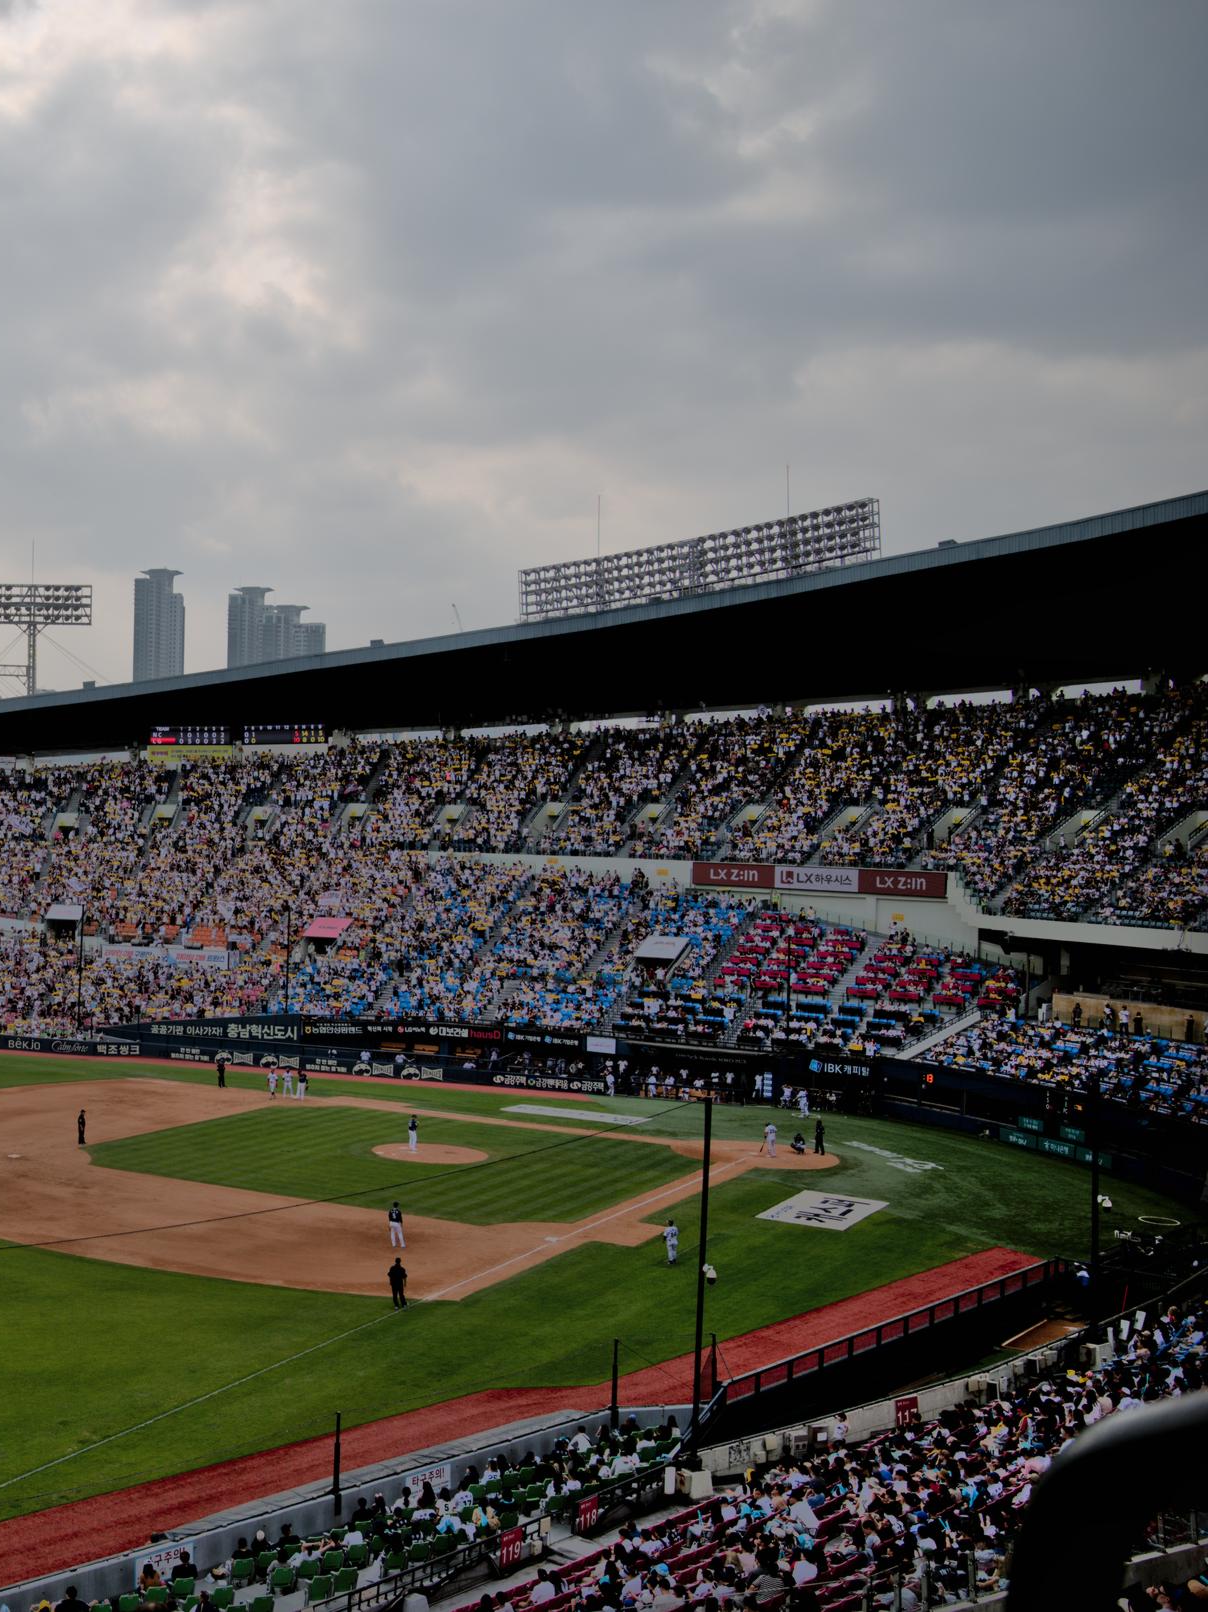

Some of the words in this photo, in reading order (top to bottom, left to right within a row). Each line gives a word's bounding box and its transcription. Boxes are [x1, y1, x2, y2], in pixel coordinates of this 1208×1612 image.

[709, 868, 728, 880] LX
[796, 872, 853, 886] LX하우시스
[876, 876, 894, 888] LX
[150, 1024, 184, 1035] 공공기관
[186, 1025, 224, 1036] 이사가자!
[226, 1023, 298, 1040] 충남혁신도시
[438, 1027, 469, 1038] 대보건설
[96, 1043, 140, 1055] 백조씽크
[824, 1062, 870, 1077] IBK캐피탈
[504, 1074, 527, 1086] 금강주택
[581, 1080, 605, 1092] 금강주택
[794, 1196, 871, 1223] 캐스퍼
[412, 1467, 445, 1486] 타구주의!
[580, 1509, 597, 1531] 118
[502, 1541, 521, 1564] 119
